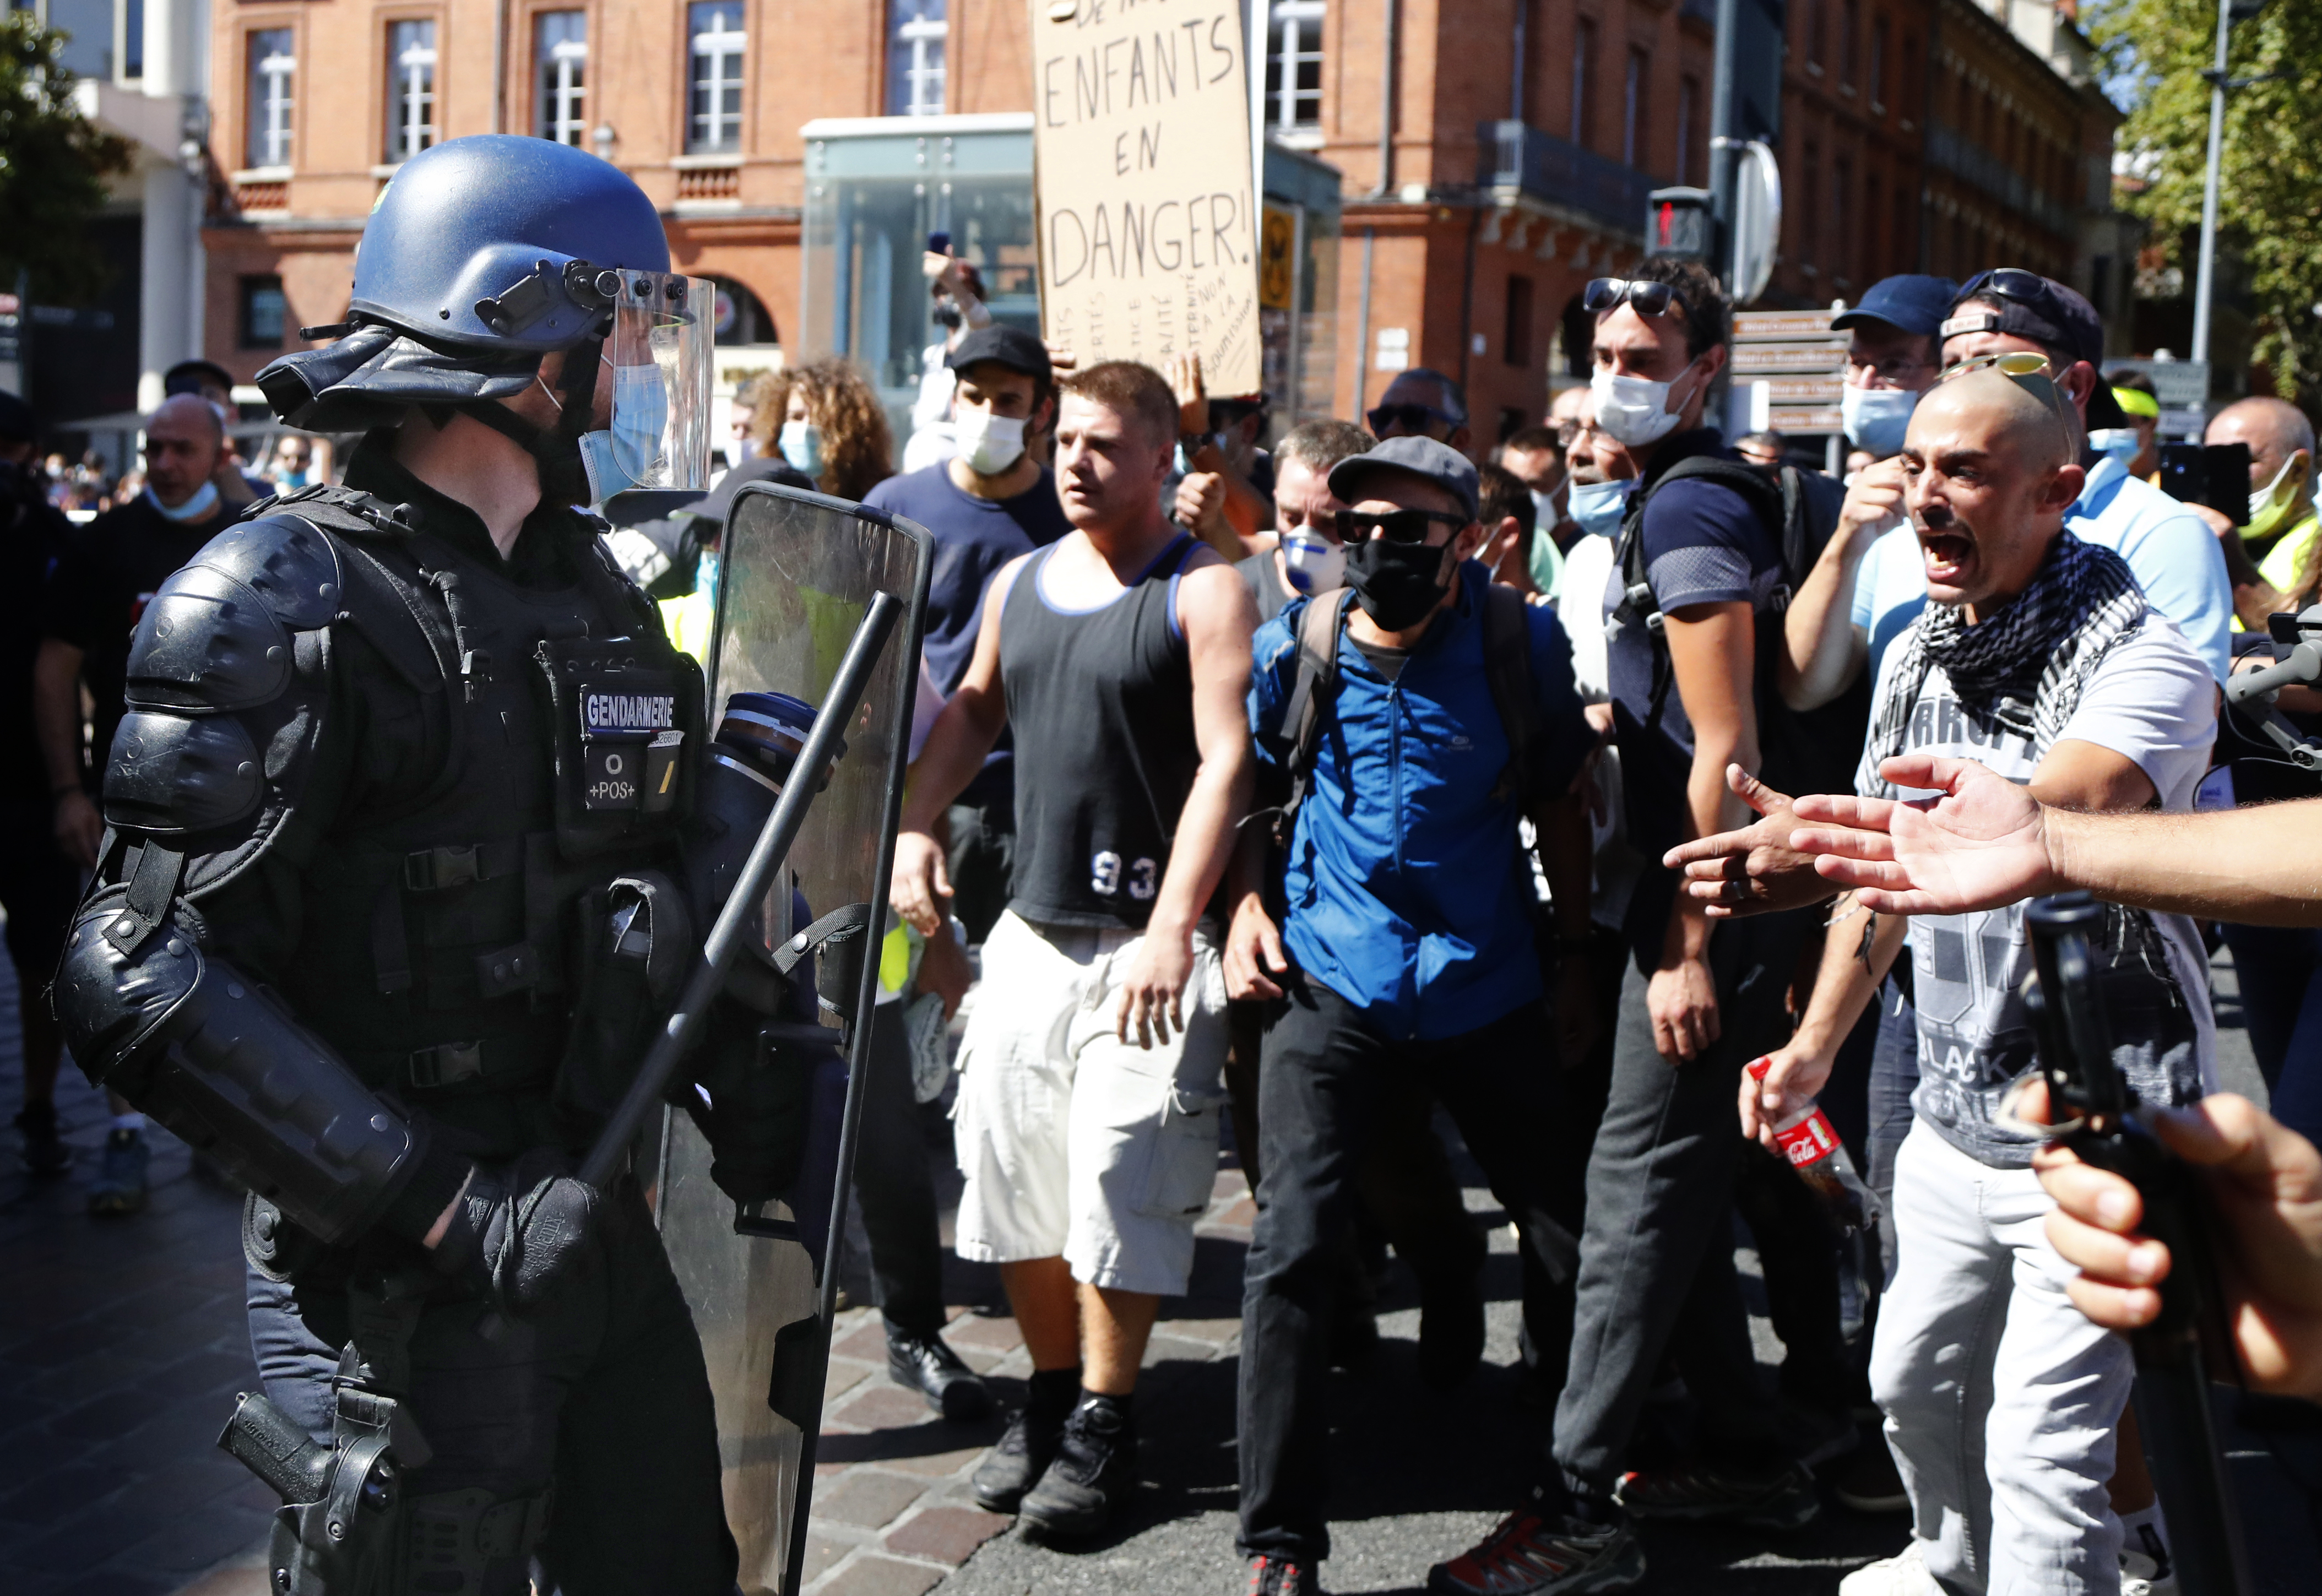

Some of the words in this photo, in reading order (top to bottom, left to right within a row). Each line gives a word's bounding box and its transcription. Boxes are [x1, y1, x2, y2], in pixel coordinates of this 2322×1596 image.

[1045, 14, 1234, 128] ENFANTS
[1115, 121, 1161, 177] EN
[1051, 190, 1250, 287] DANGER!
[587, 694, 674, 728] GENDARMERIE
[606, 754, 623, 775] O
[1092, 850, 1157, 900] 93
